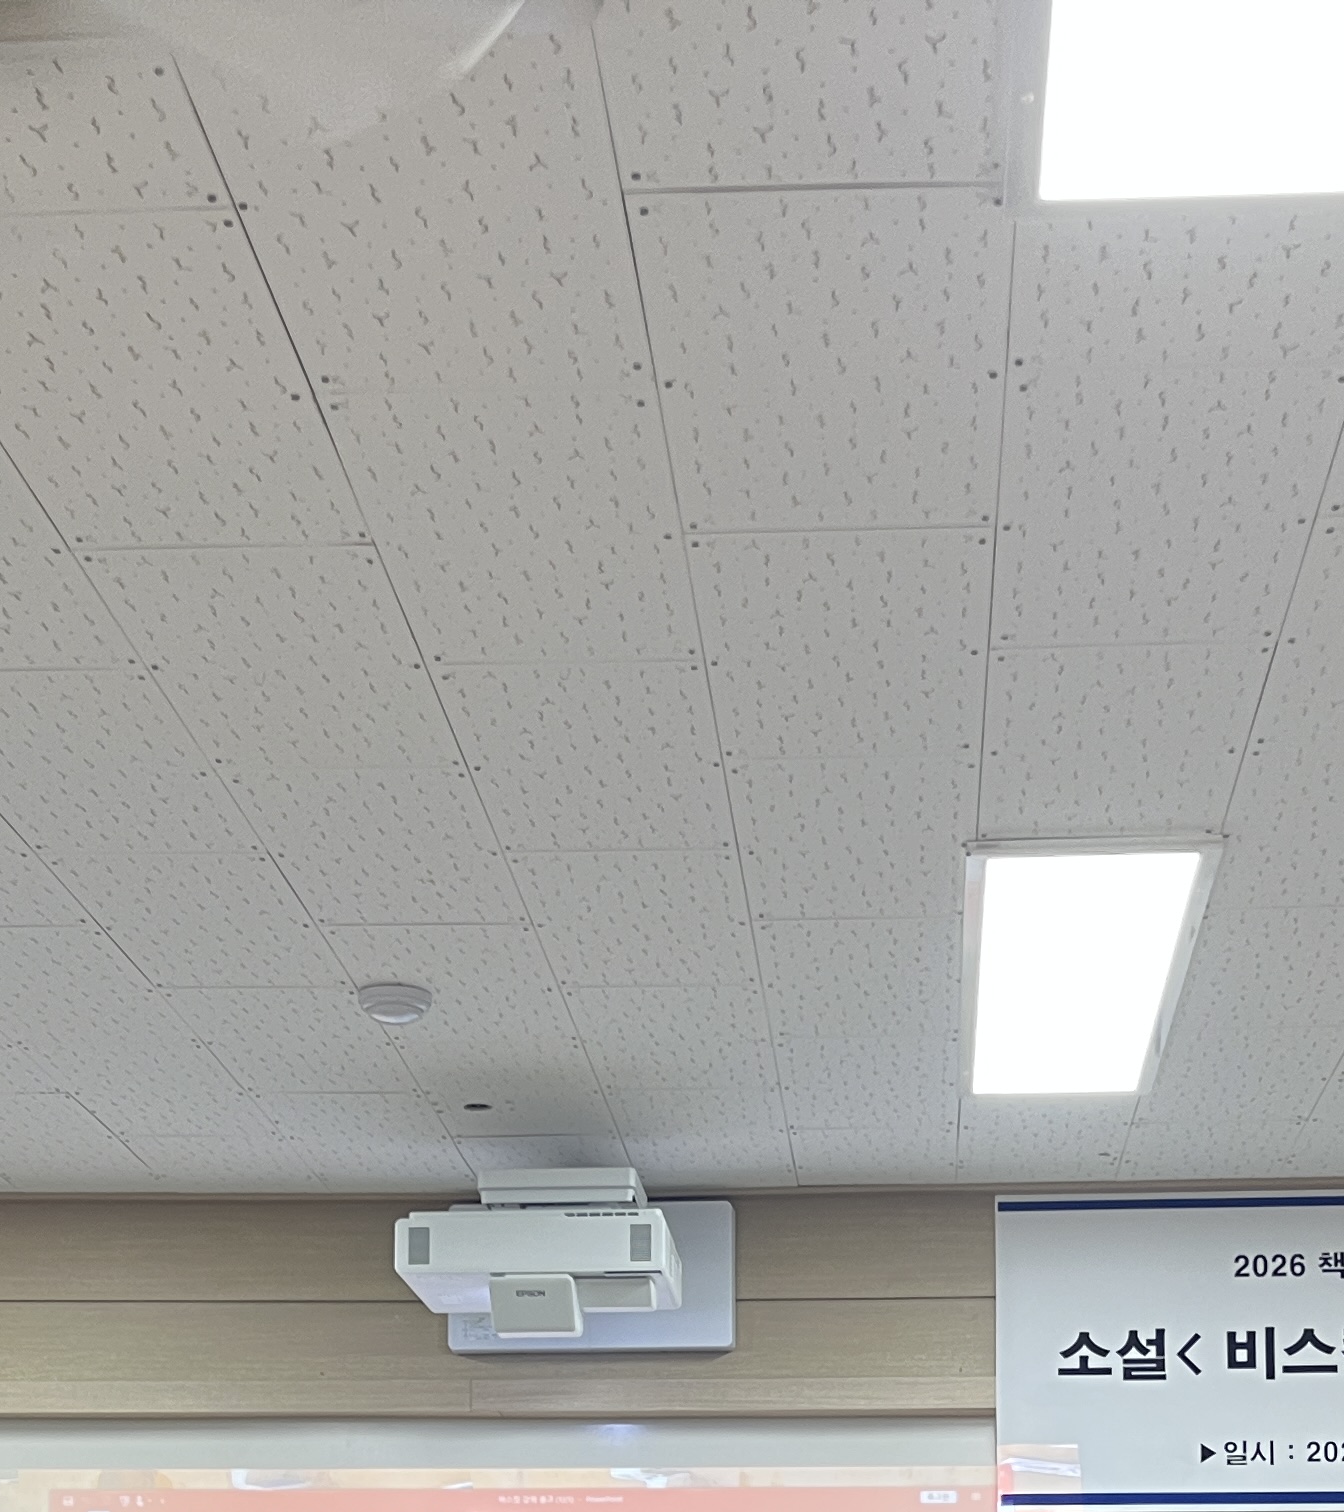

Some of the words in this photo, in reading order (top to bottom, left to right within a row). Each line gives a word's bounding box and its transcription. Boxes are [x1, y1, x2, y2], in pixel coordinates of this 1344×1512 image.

[1233, 1253, 1306, 1278] 2026
[1057, 1327, 1202, 1381] 소설<
[1223, 1439, 1275, 1466] 일시
